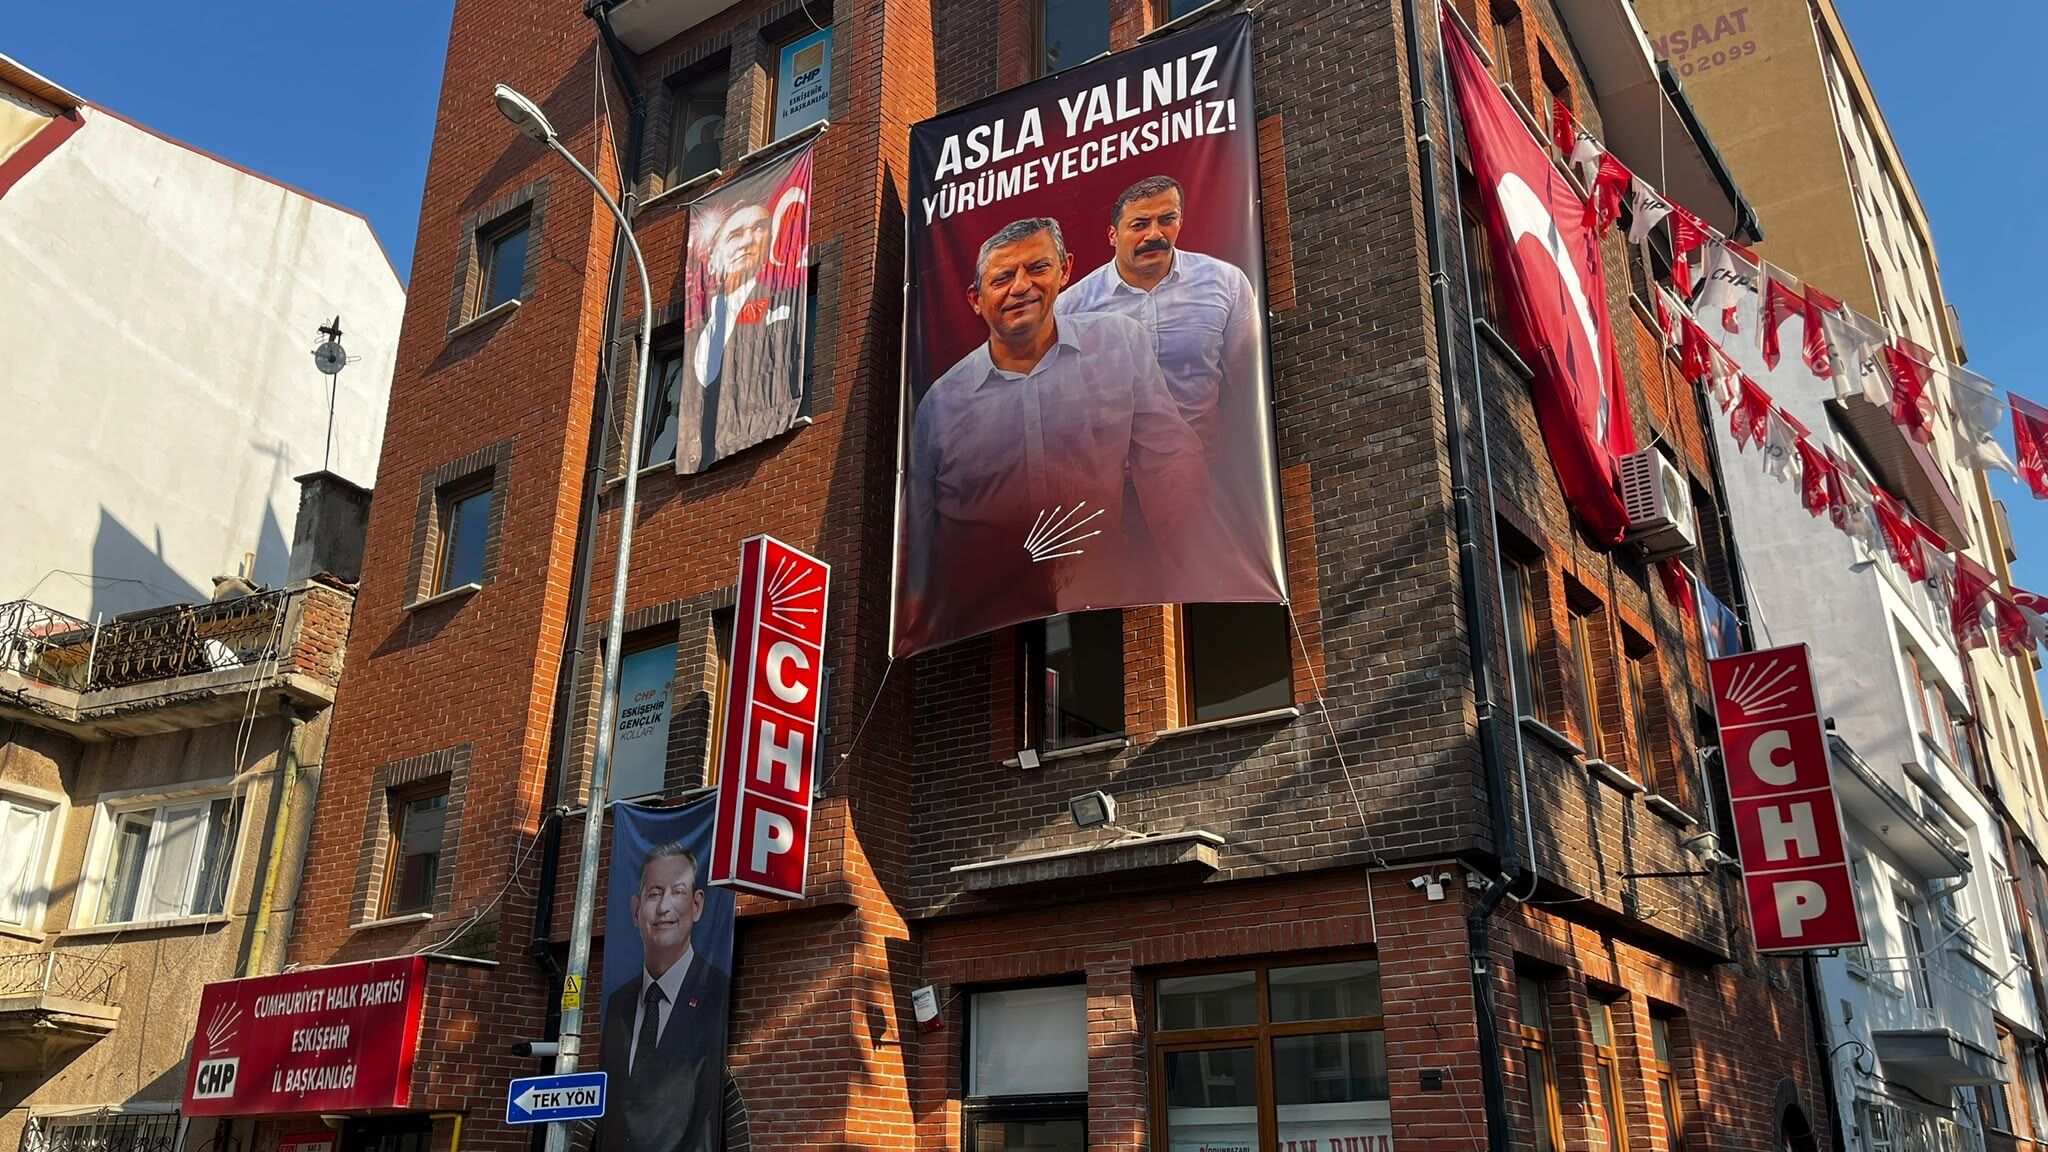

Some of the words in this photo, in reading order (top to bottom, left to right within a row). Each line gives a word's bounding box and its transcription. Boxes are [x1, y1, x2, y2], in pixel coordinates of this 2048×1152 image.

[794, 67, 821, 88] CHP
[789, 85, 823, 106] ESKİŞEHİR
[934, 106, 1045, 182] ASLA
[1058, 45, 1219, 139] YALNIZ
[922, 98, 1237, 227] YÜRÜMEYECEKSİNİZ!
[622, 700, 665, 719] ESKİŞEHİR
[634, 688, 657, 703] CHP
[619, 712, 662, 731] GENÇLİK
[620, 726, 655, 741] KOLLARI
[751, 640, 811, 876] CHP
[1749, 729, 1828, 939] CHP
[254, 984, 325, 1019] CUMHURİYET
[326, 983, 360, 1010] HALK
[360, 972, 406, 1006] PARTİSİ
[291, 1018, 350, 1057] ESKİŞEHİR
[199, 1062, 235, 1095] CHP
[272, 1063, 282, 1093] İL
[285, 1058, 358, 1098] BAŞKANLIĞI
[532, 1092, 562, 1109] TEK
[566, 1087, 596, 1106] YÖN
